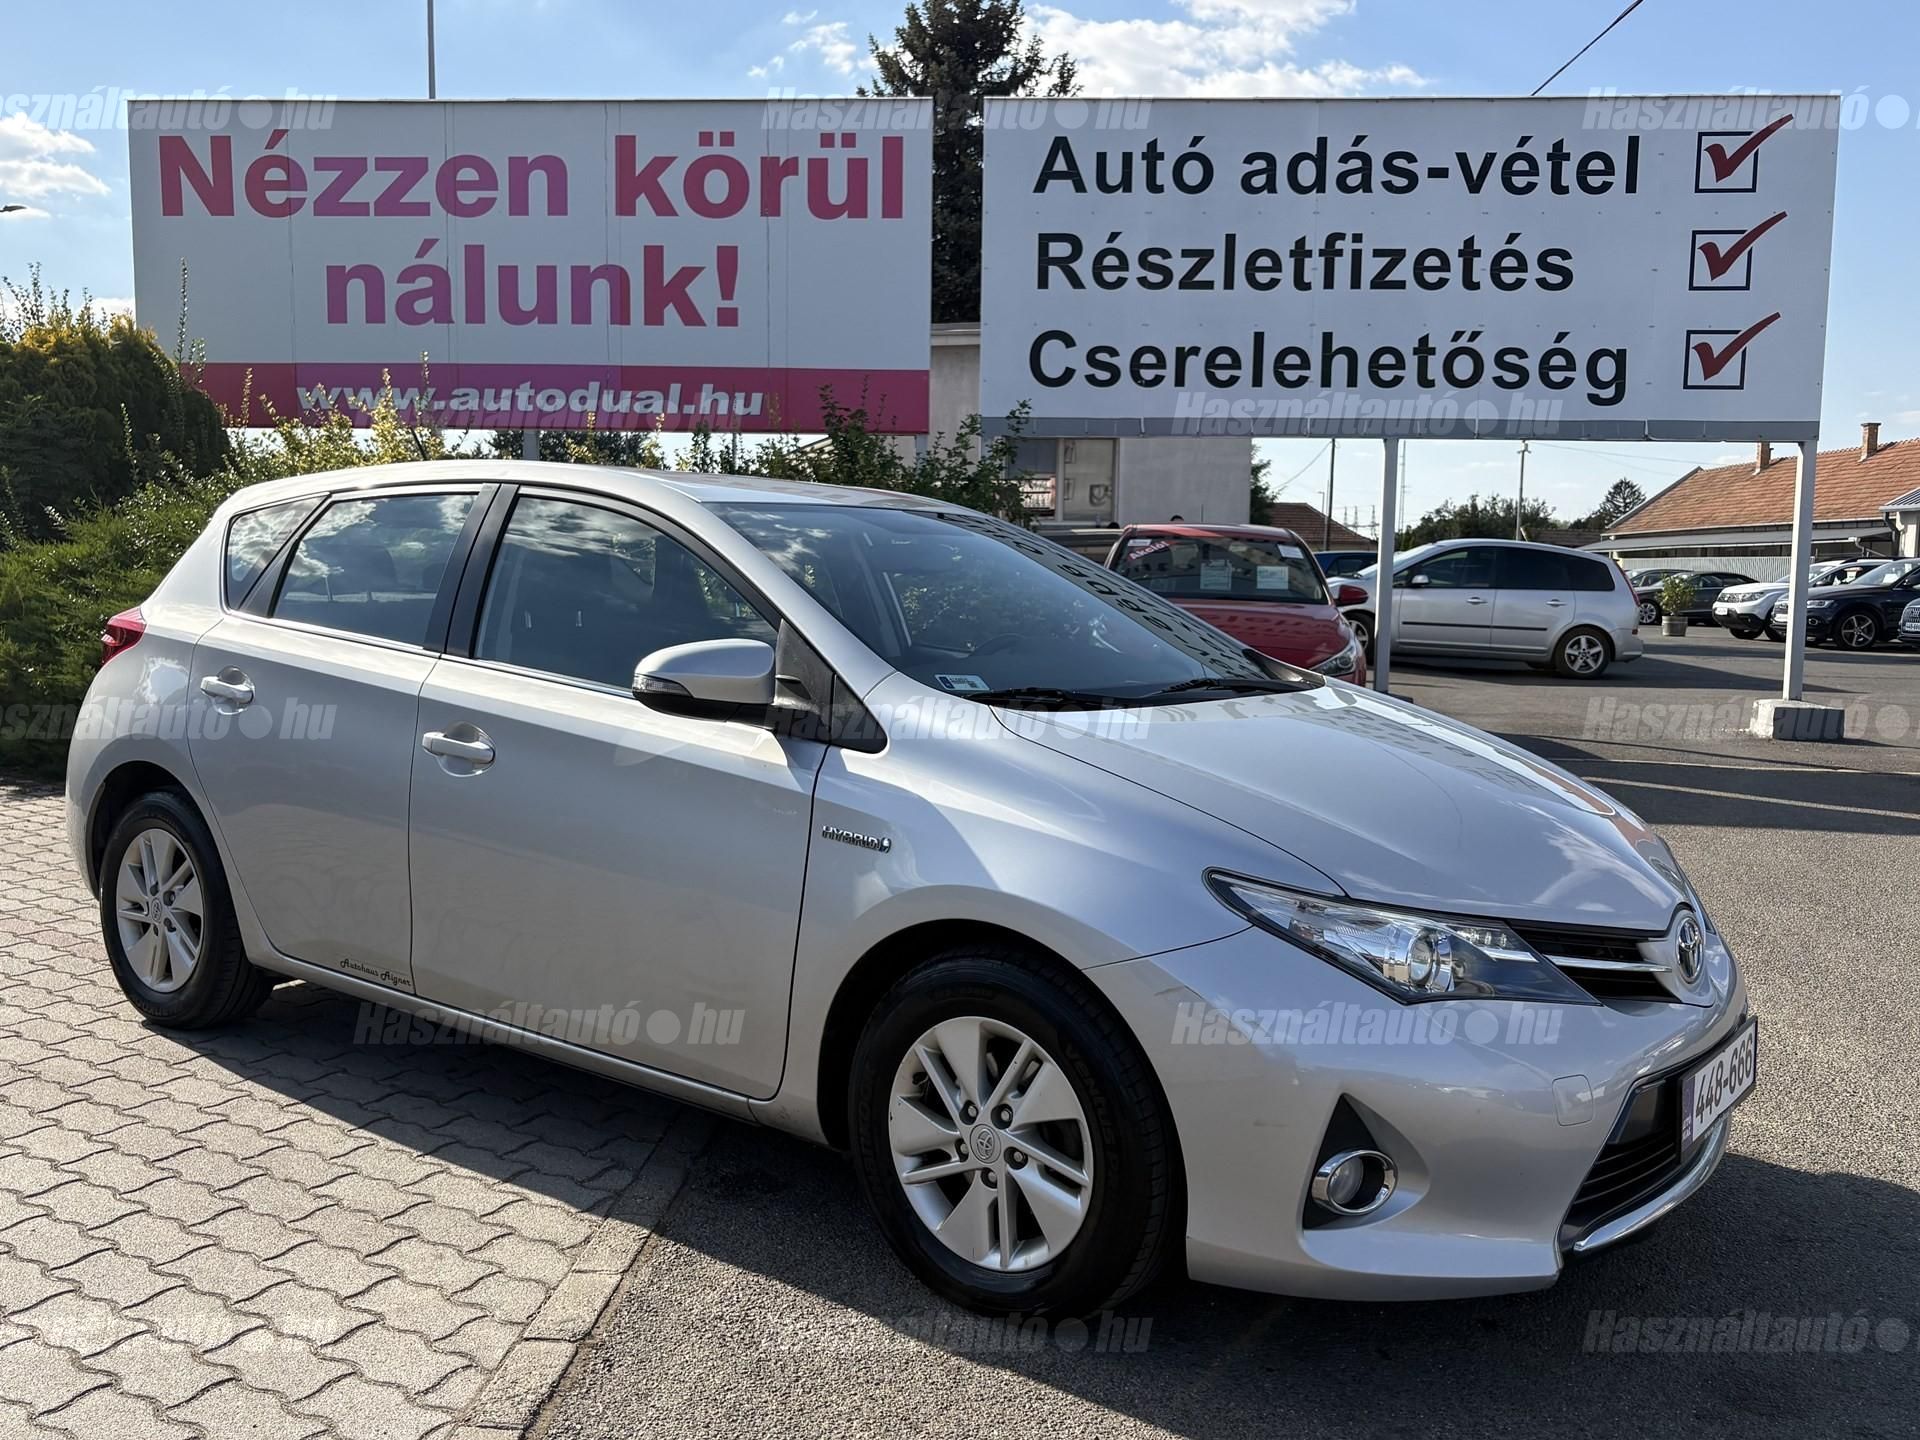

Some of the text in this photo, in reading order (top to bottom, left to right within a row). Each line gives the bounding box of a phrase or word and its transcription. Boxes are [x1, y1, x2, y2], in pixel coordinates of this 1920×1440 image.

[160, 128, 904, 219] Nézzen körül
[1032, 134, 1640, 197] Autó adás-vétel
[326, 238, 740, 327] nálunk!
[1037, 231, 1575, 292] Részletfizetés
[295, 381, 764, 417] www.autodual.hu
[1029, 329, 1628, 407] Cserelehetőség
[821, 825, 881, 850] HYBRID
[1695, 1032, 1754, 1124] 448-666
